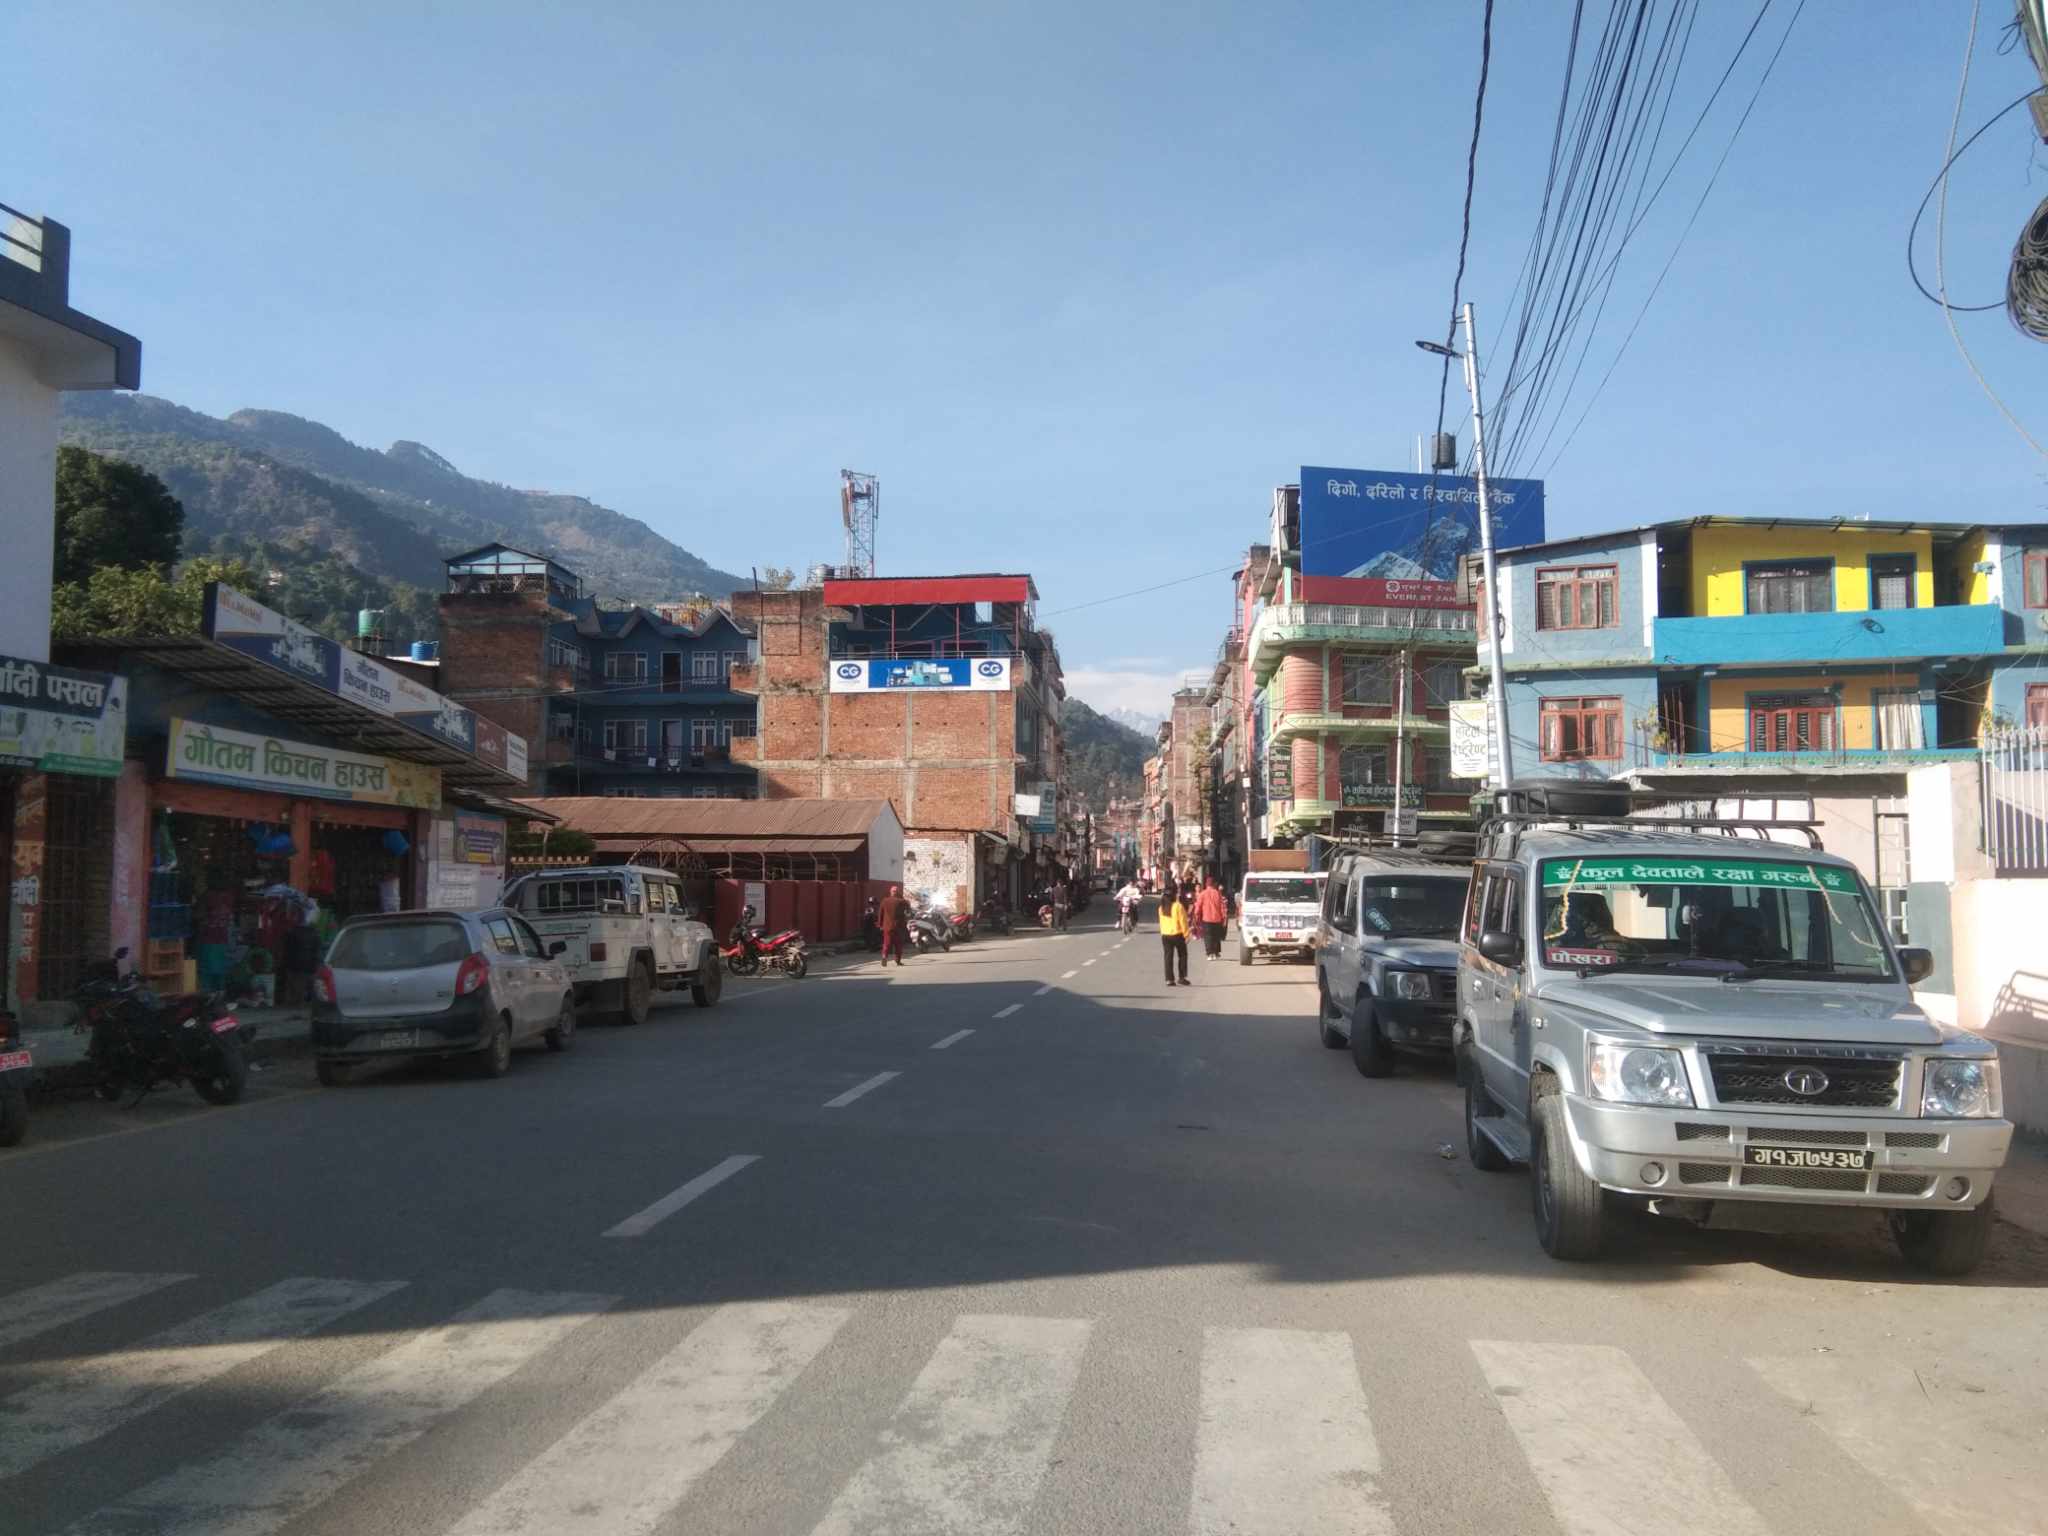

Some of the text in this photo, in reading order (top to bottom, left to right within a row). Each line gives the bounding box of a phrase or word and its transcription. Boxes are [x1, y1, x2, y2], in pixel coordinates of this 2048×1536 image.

[1410, 488, 1419, 500] र
[46, 675, 105, 708] पसल
[183, 727, 388, 792] गौतम किचन हाउस
[1581, 867, 1624, 880] कुल
[1631, 864, 1705, 880] देवताले
[1711, 868, 1755, 881] रक्षा
[1551, 950, 1612, 965] पोखरा
